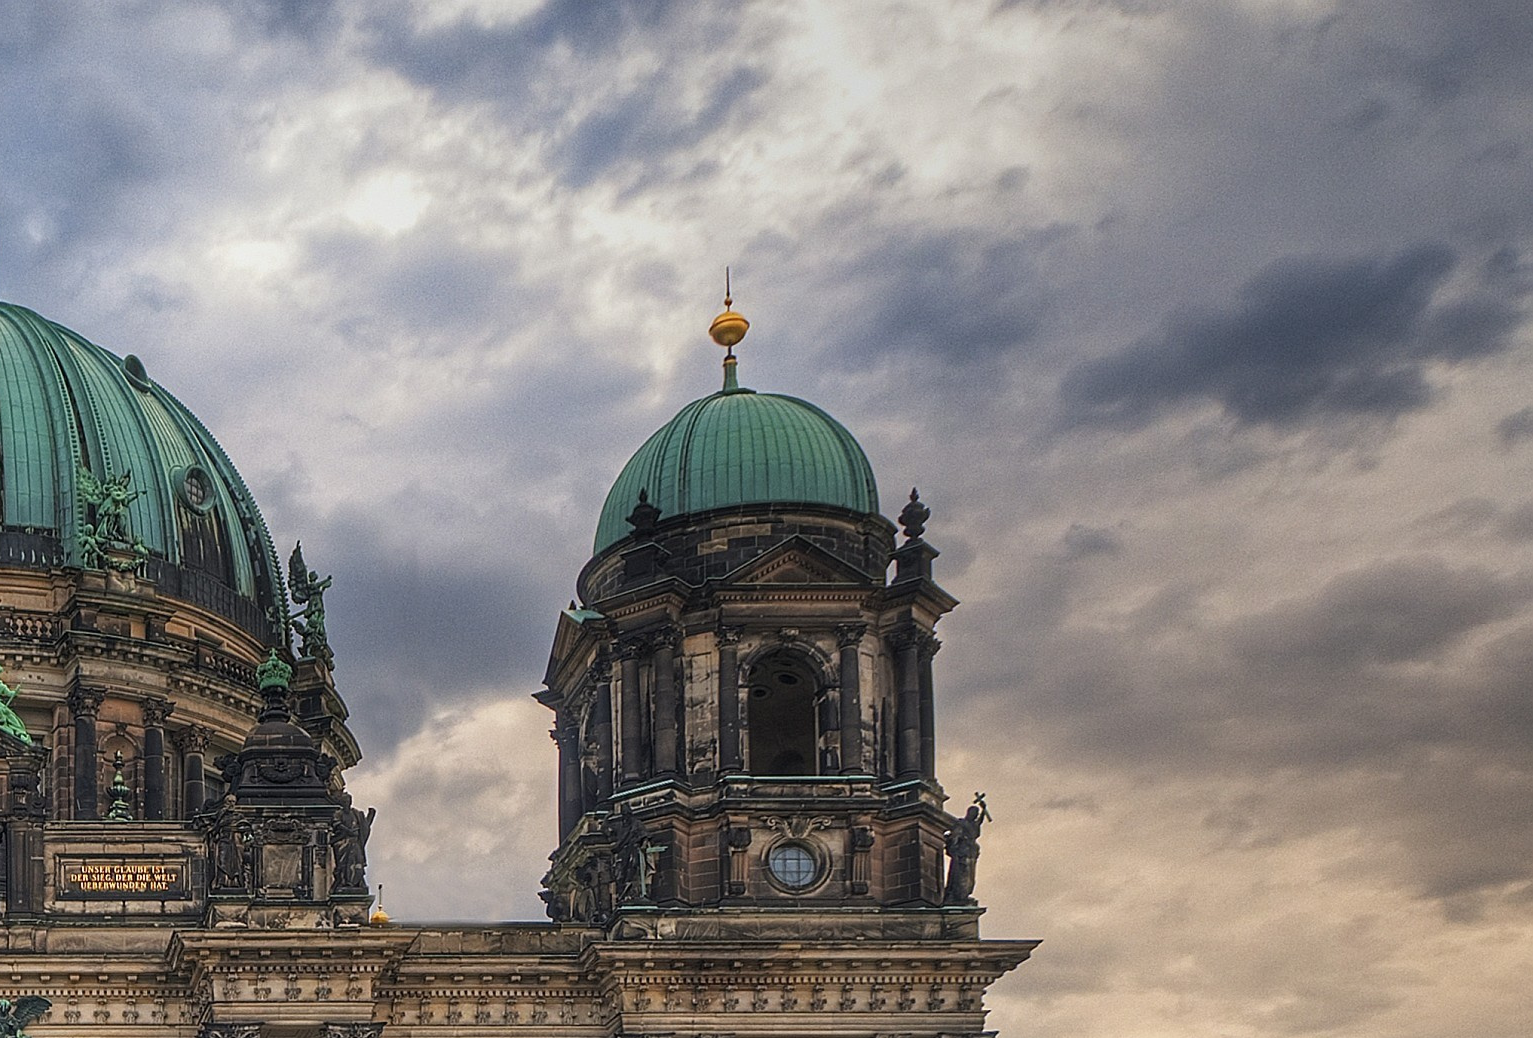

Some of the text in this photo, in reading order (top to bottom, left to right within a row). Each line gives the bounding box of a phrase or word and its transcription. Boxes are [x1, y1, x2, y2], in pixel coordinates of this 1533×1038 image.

[82, 865, 165, 874] UNSER GLAUBE IST
[71, 874, 89, 882] DER
[116, 874, 133, 882] DER
[136, 874, 152, 882] DIE
[154, 874, 177, 882] WELT
[80, 882, 148, 890] UEBERWUNDEN
